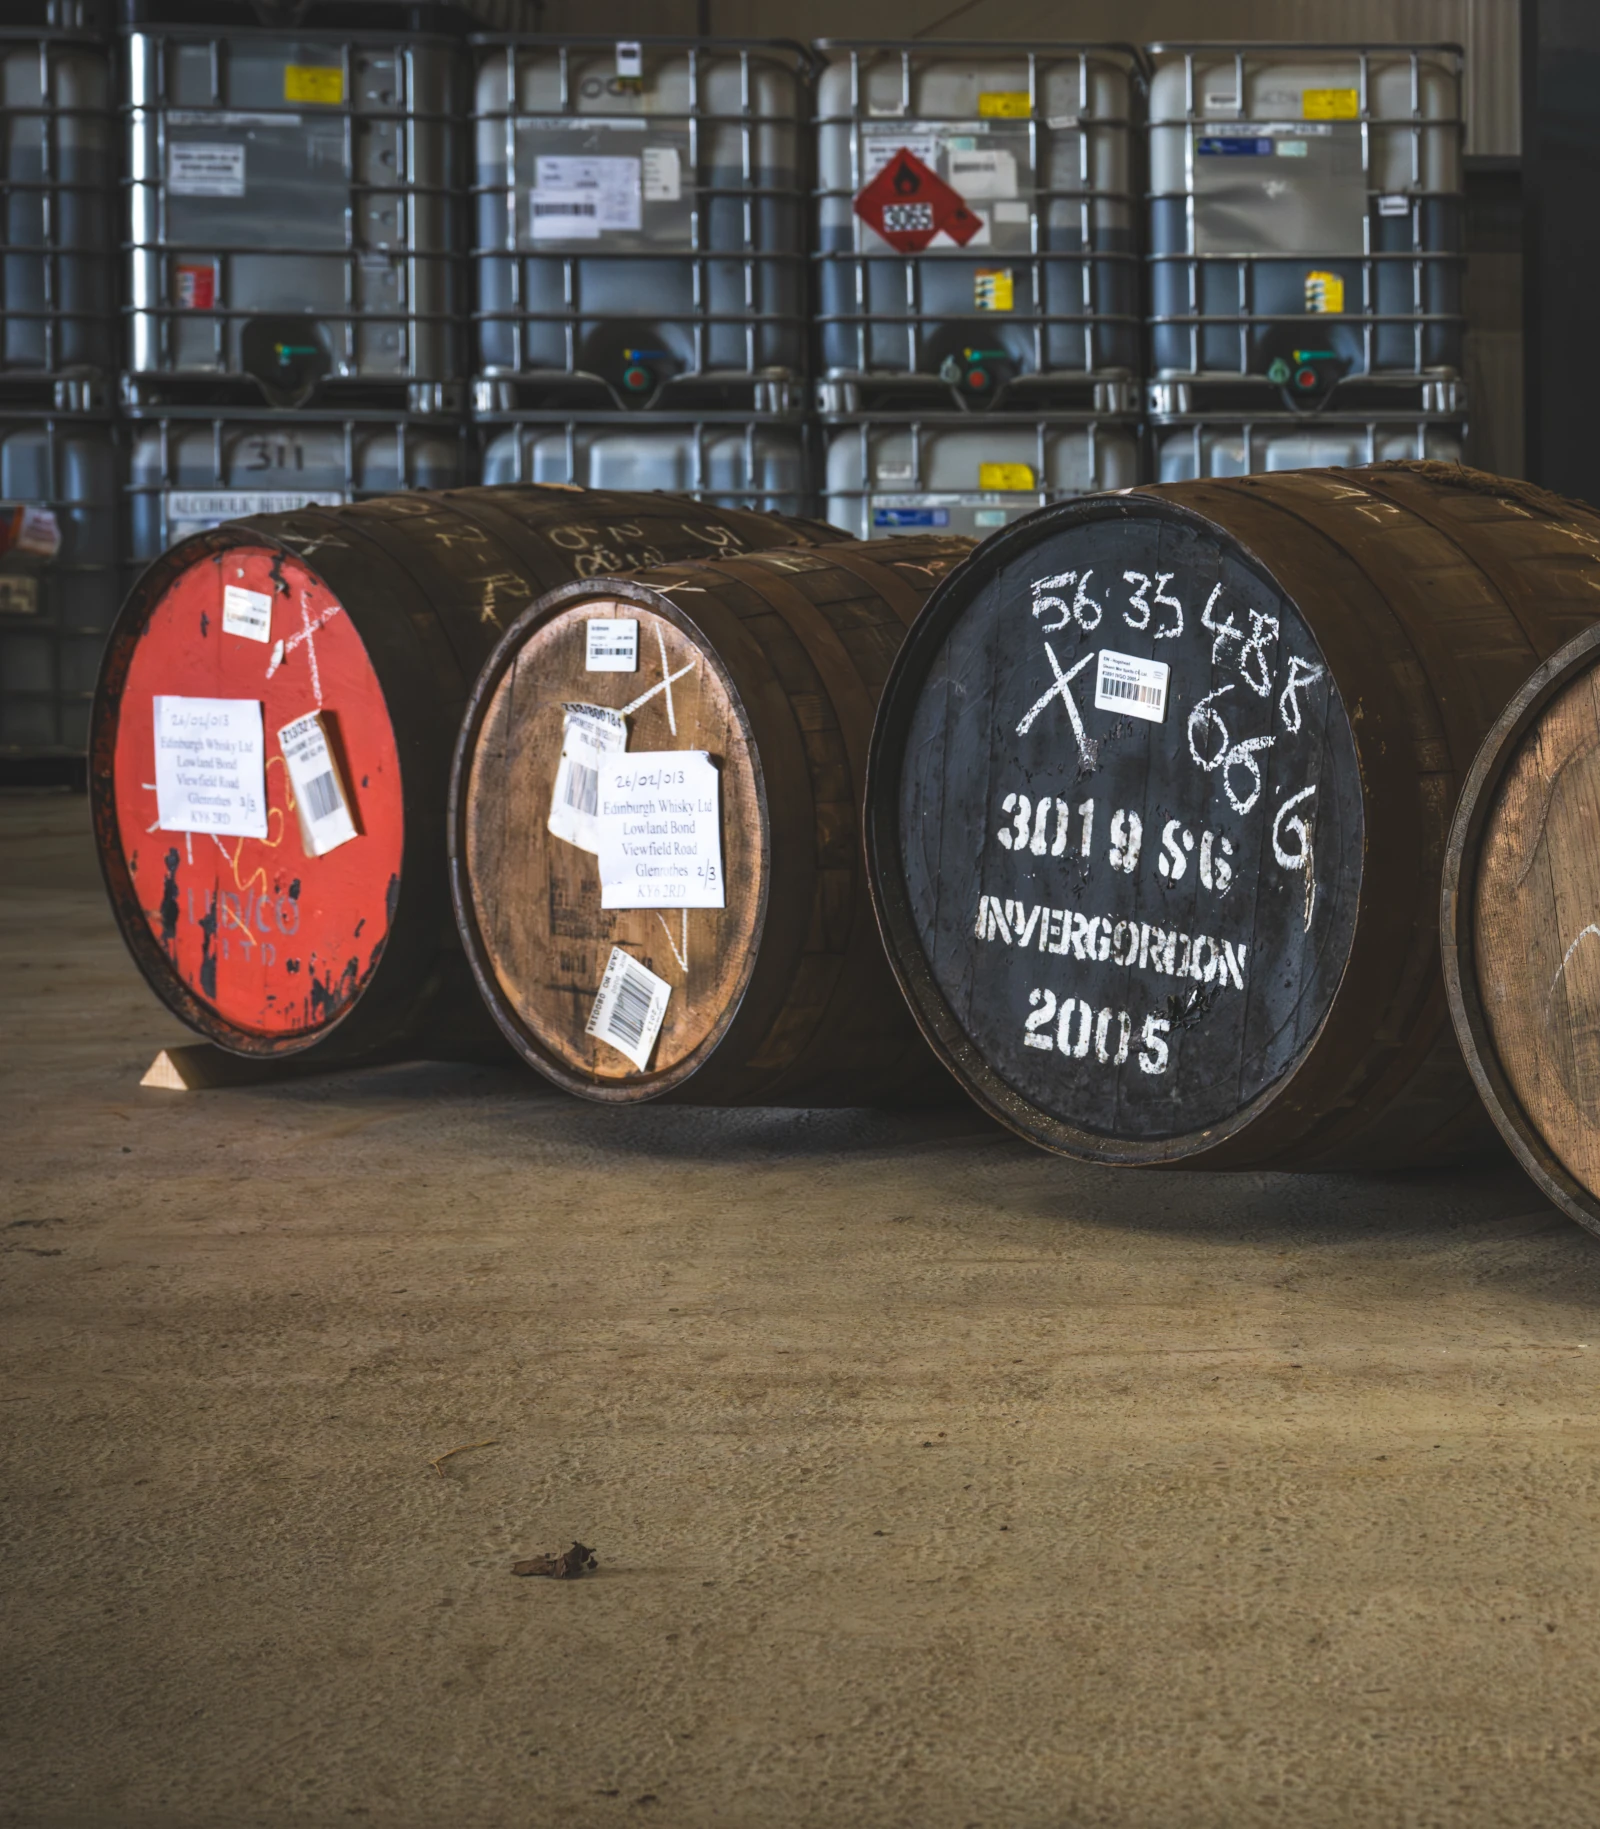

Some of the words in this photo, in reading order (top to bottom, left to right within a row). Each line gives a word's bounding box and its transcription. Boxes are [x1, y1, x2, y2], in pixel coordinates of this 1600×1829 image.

[884, 204, 933, 232] 3065
[160, 736, 205, 753] Edinburgh
[206, 738, 236, 755] Whisky
[239, 740, 254, 753] Ltd
[177, 755, 214, 769] Lowland
[215, 757, 238, 770] Bond
[176, 773, 218, 788] Viewfield
[219, 775, 240, 789] Road
[615, 769, 685, 792] 26/02/013
[188, 792, 232, 806] Glenrothes
[603, 799, 656, 817] Edinburgh
[659, 799, 695, 816] Whisky
[698, 798, 712, 812] Ltd
[623, 821, 668, 835] Lowland
[671, 820, 696, 834] Bond
[622, 841, 672, 856] Viewfield
[674, 841, 698, 855] Road
[635, 862, 688, 877] Glenrothes
[697, 859, 717, 890] 2/3
[637, 884, 660, 898] KY6
[663, 884, 687, 898] 2RD
[974, 895, 1247, 991] INVERGORDON
[608, 949, 620, 972] CASK
[602, 977, 612, 988] NO
[1024, 988, 1171, 1075] 2005
